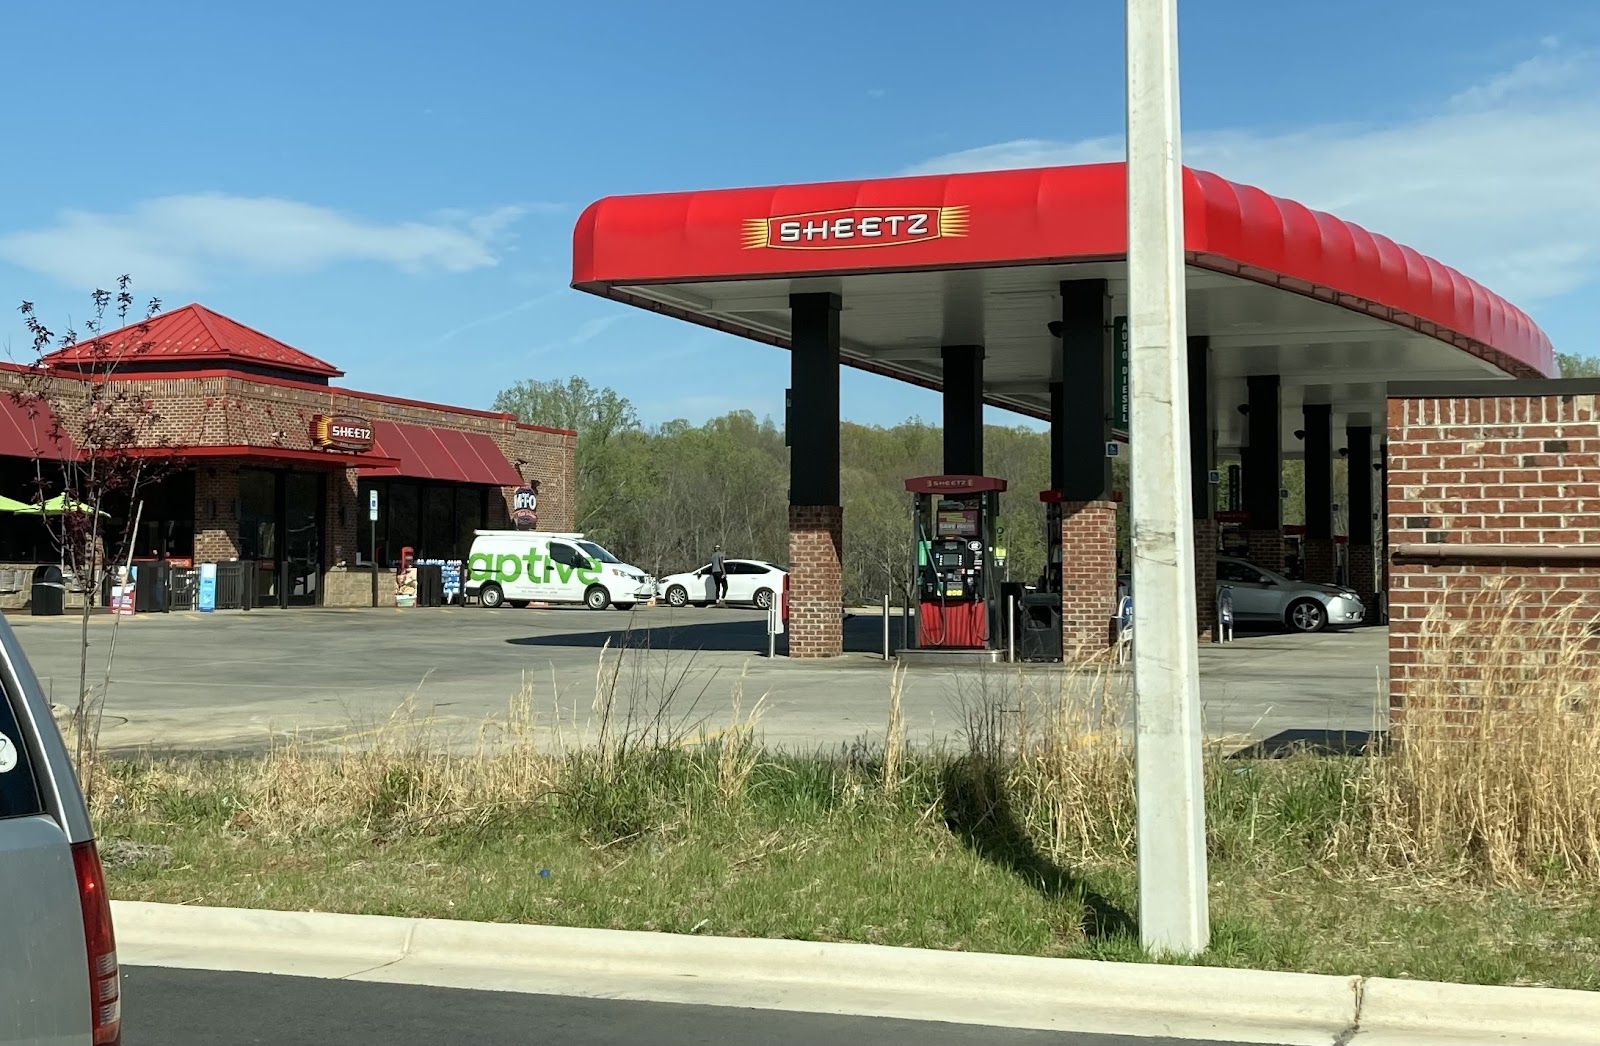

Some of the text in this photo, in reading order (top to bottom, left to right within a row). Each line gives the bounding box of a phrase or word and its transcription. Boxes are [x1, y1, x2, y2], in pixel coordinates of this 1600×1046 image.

[780, 213, 928, 242] SHEETZ
[332, 425, 371, 440] SHEETZ
[468, 540, 603, 586] aptive
